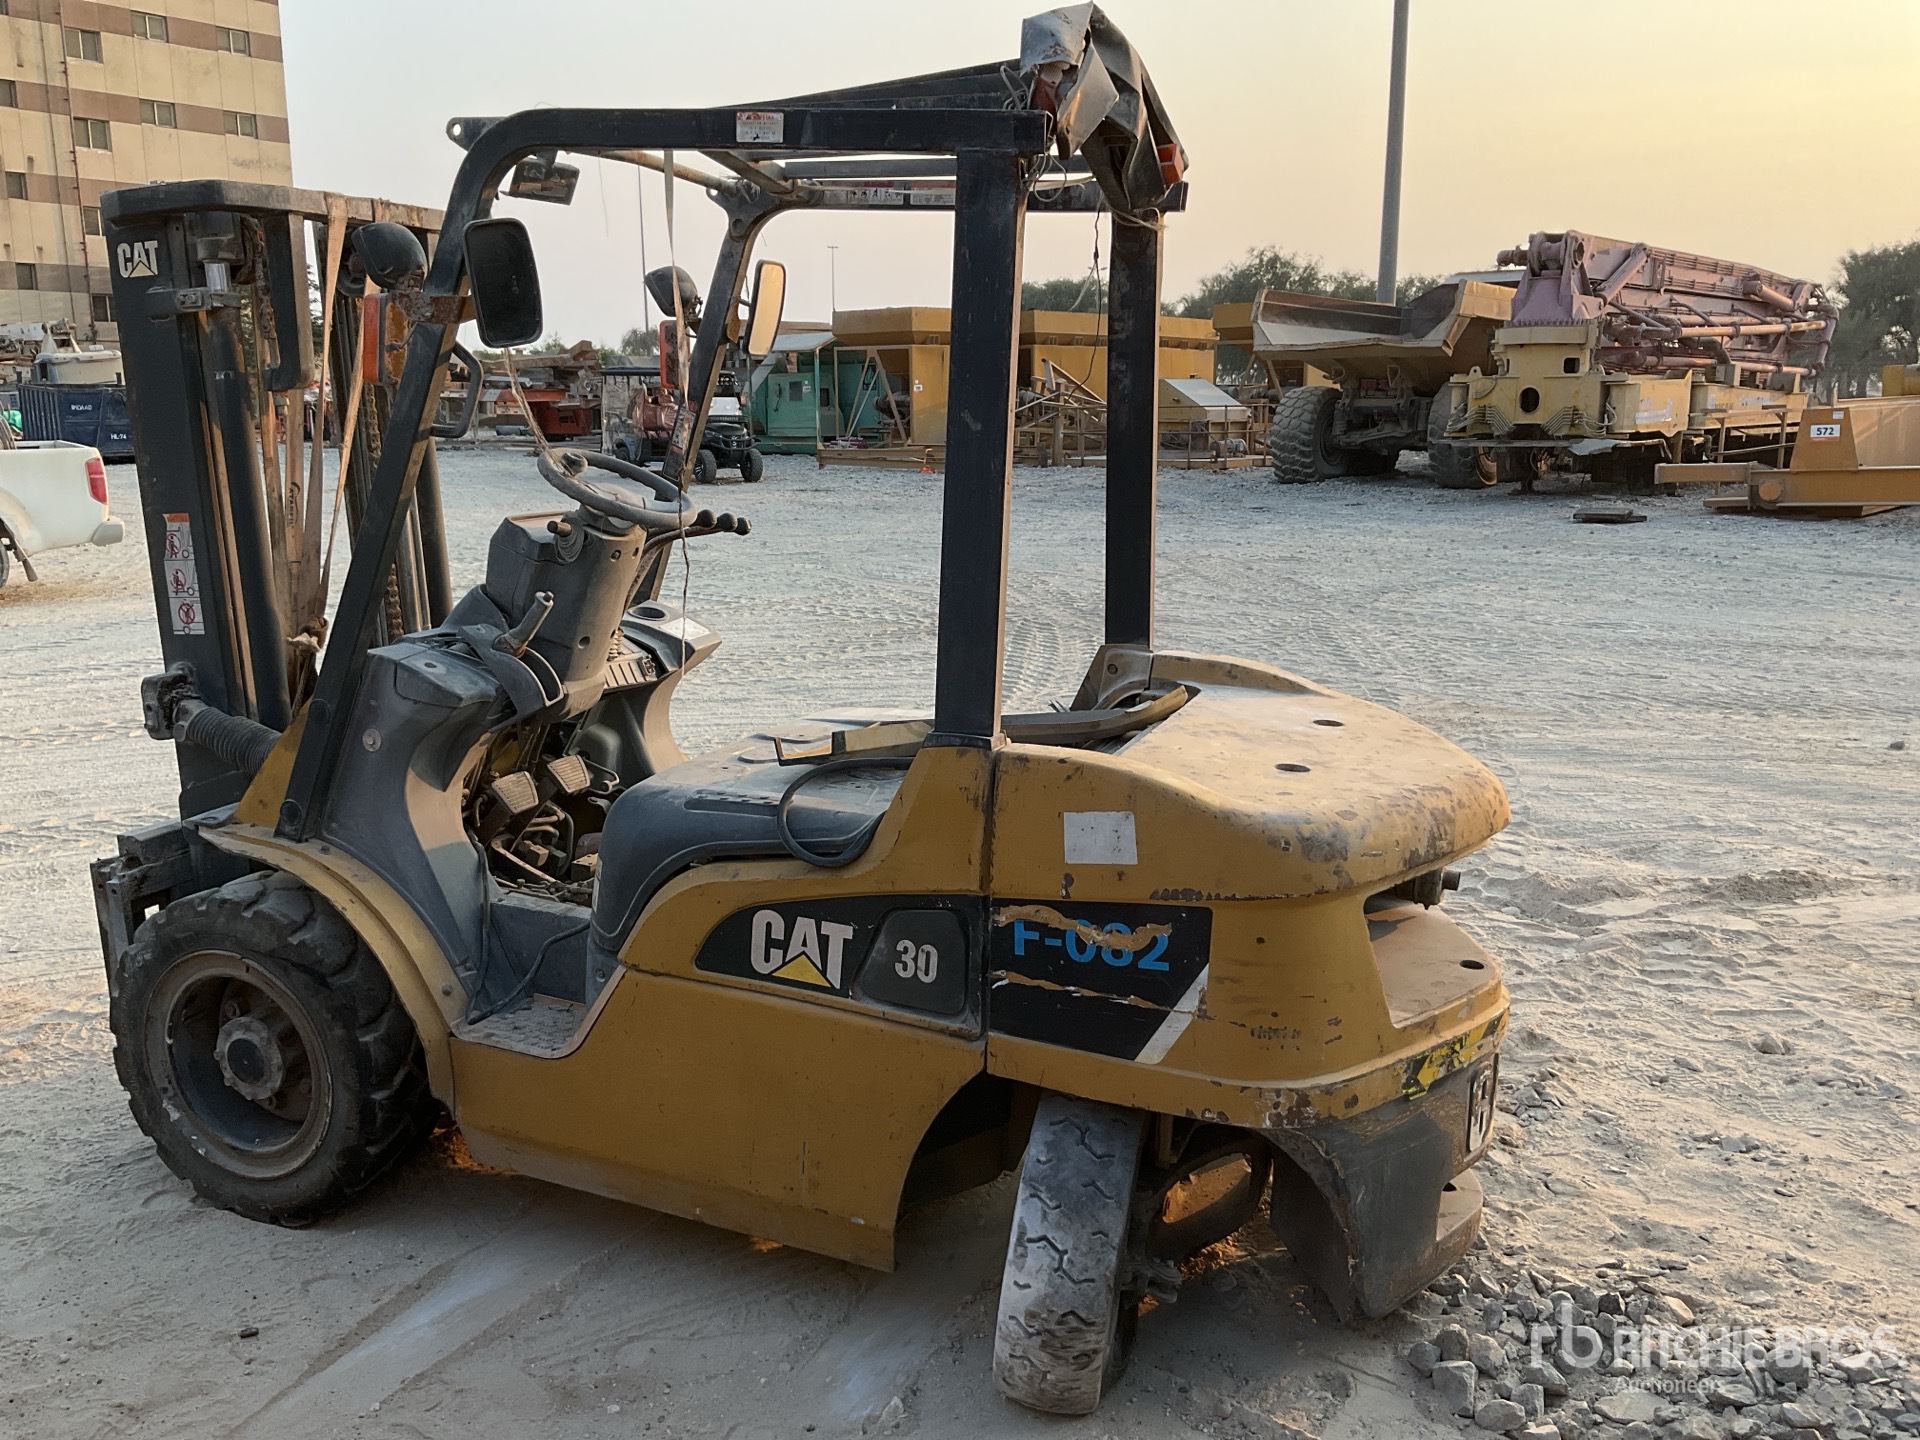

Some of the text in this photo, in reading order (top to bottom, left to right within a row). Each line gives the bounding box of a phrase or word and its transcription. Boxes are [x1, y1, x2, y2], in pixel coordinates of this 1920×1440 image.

[117, 240, 158, 278] CAT
[1816, 427, 1834, 436] 572
[751, 909, 854, 990] CAT
[895, 939, 939, 983] 30
[1013, 917, 1170, 971] F-082
